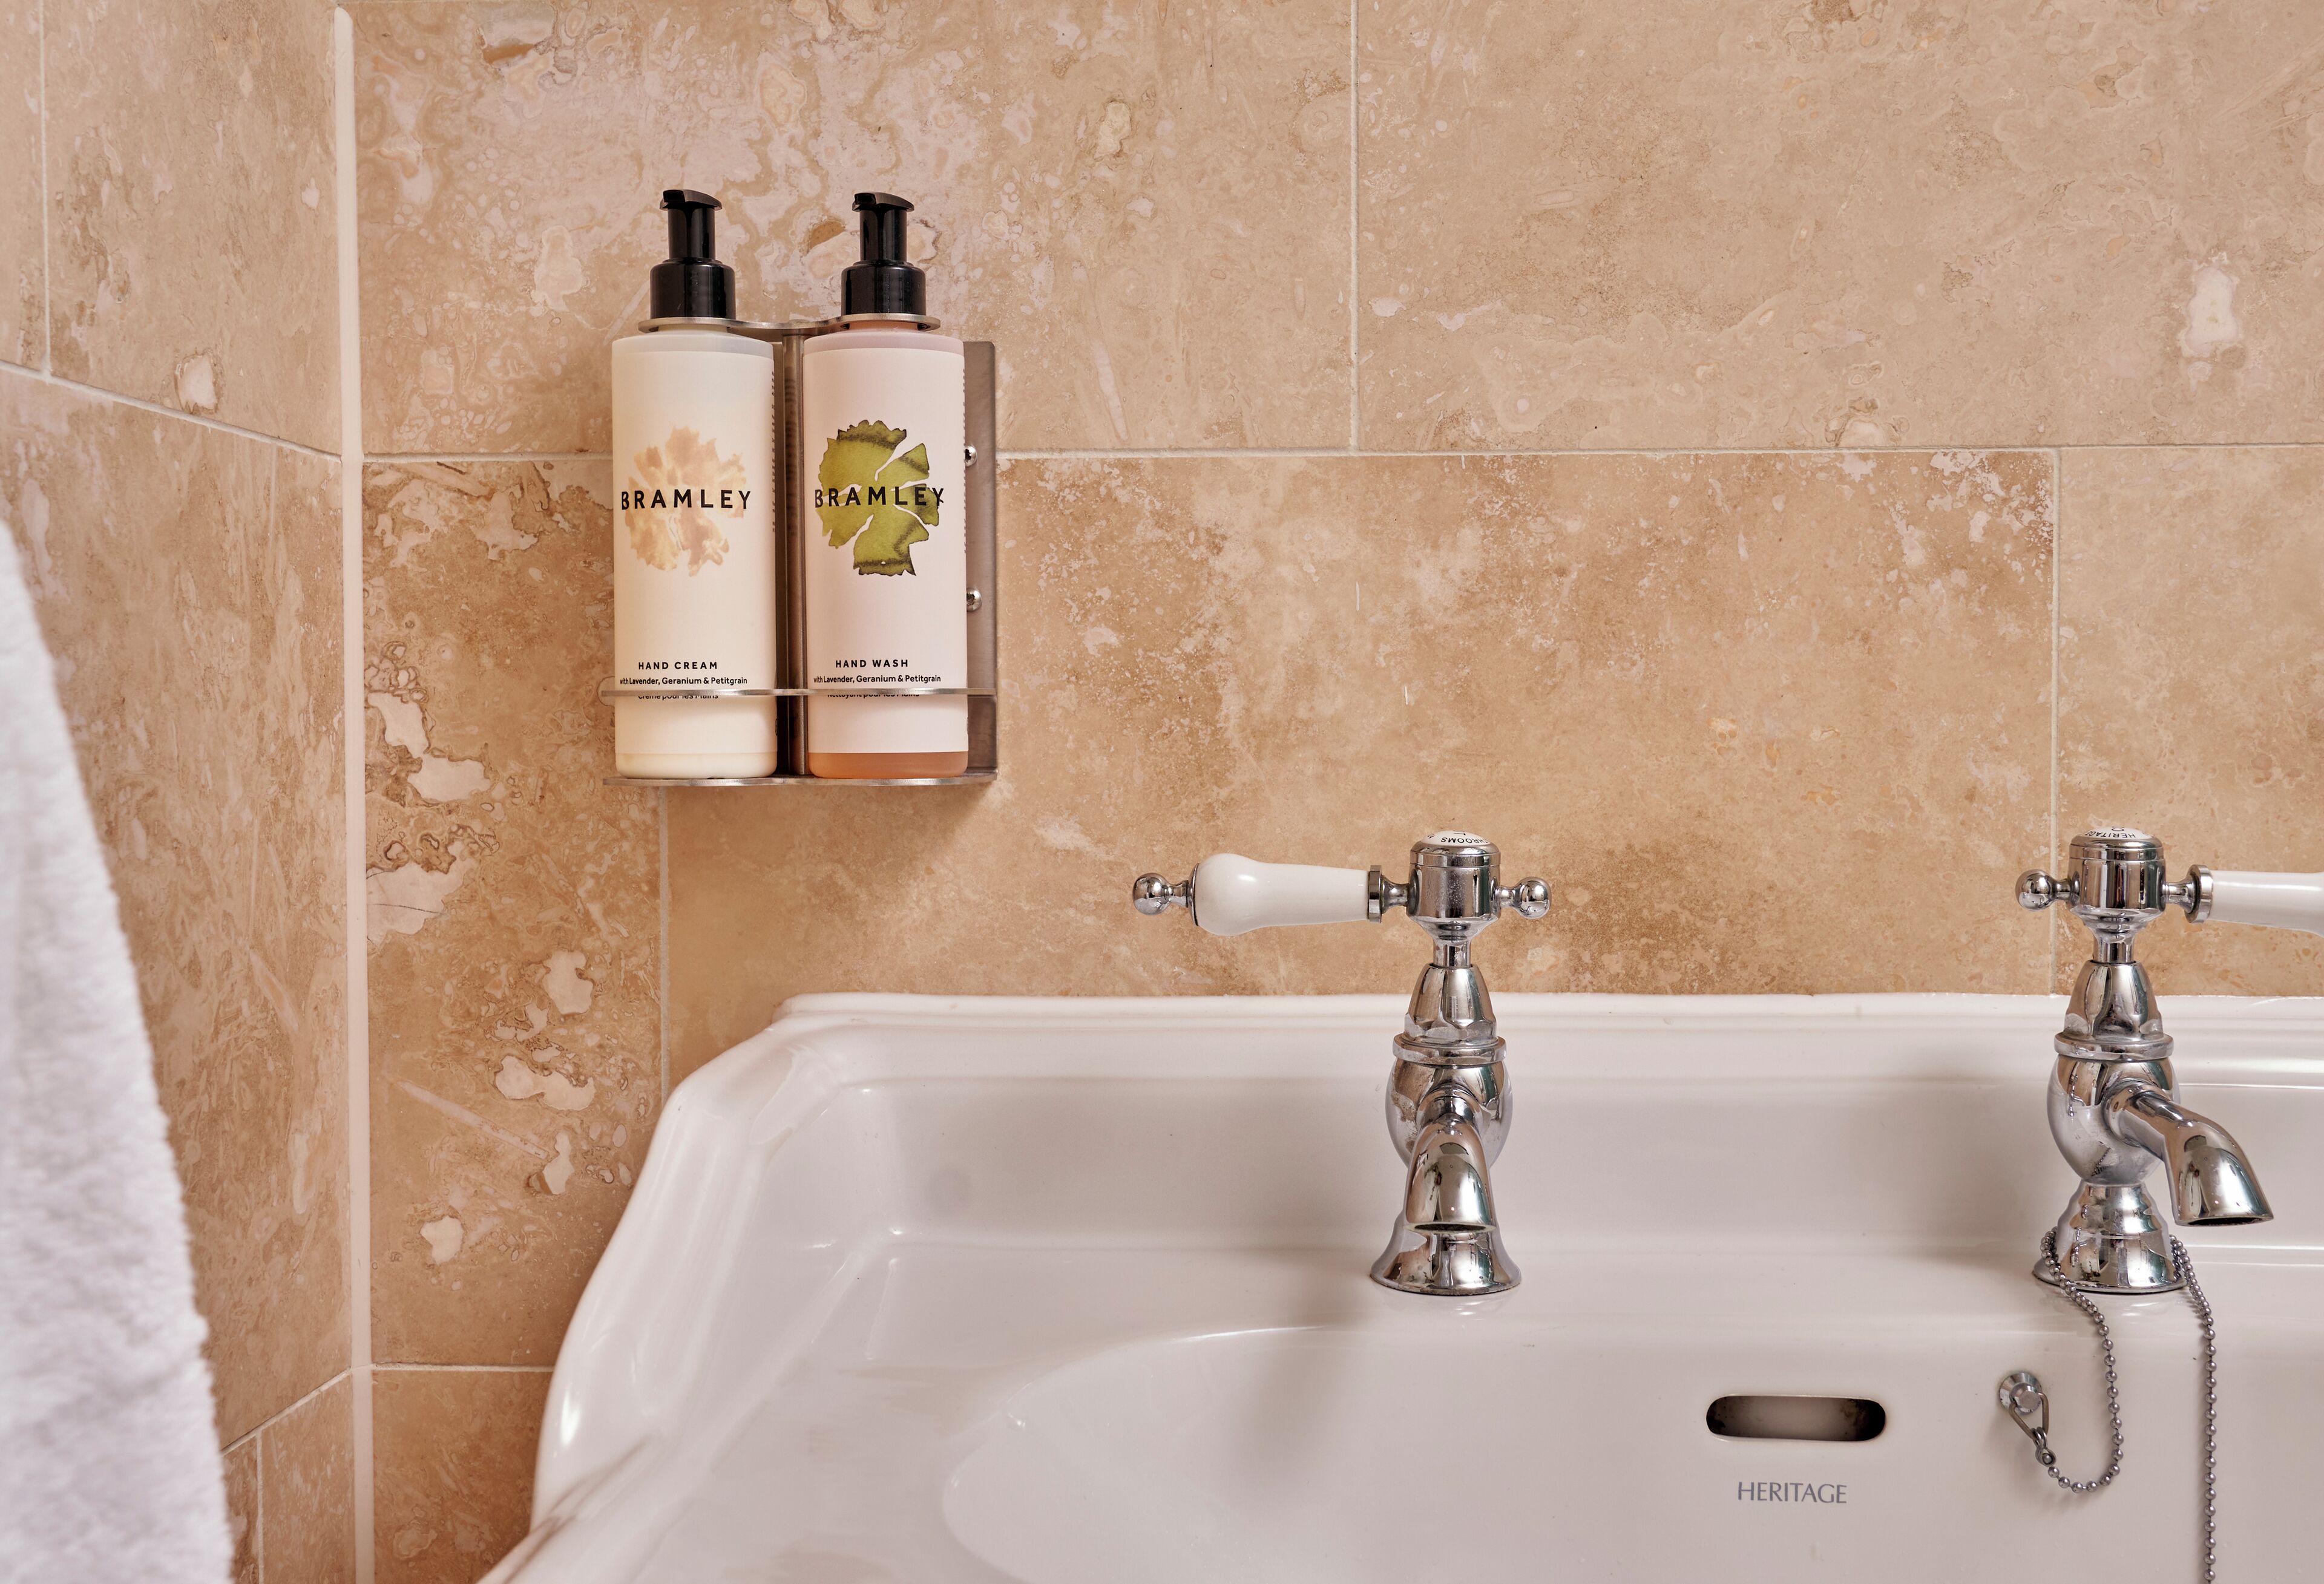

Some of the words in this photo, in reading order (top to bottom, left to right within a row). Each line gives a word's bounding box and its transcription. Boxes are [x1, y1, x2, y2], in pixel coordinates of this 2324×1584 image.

[620, 488, 752, 511] BRAMLEY
[814, 486, 945, 509] BRAMLEY
[638, 661, 669, 670] HAND
[674, 661, 718, 670] CREAM
[835, 659, 867, 668] HAND
[872, 659, 908, 667] WASH
[629, 677, 660, 686] Lavender,
[711, 676, 747, 686] Petitgrain
[824, 675, 855, 684] Lavender,
[905, 675, 941, 684] Petitgrain
[1738, 1482, 1847, 1504] HERITAGE
